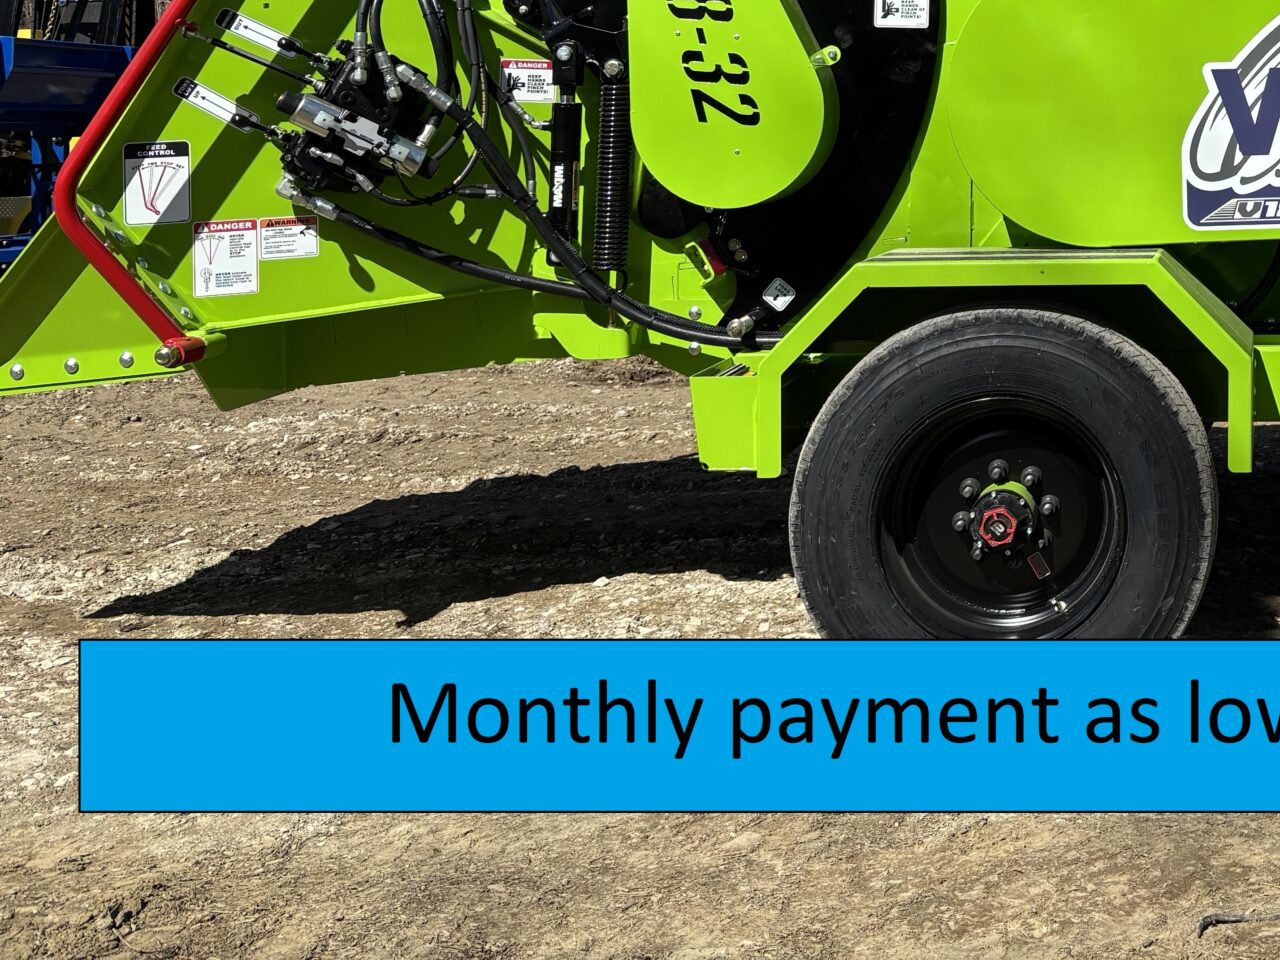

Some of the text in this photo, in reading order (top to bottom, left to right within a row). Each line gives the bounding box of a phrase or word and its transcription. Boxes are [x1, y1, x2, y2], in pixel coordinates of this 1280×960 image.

[234, 18, 244, 31] OUT
[193, 91, 200, 99] UP
[552, 166, 565, 207] MAXIM
[210, 222, 252, 231] DANGER
